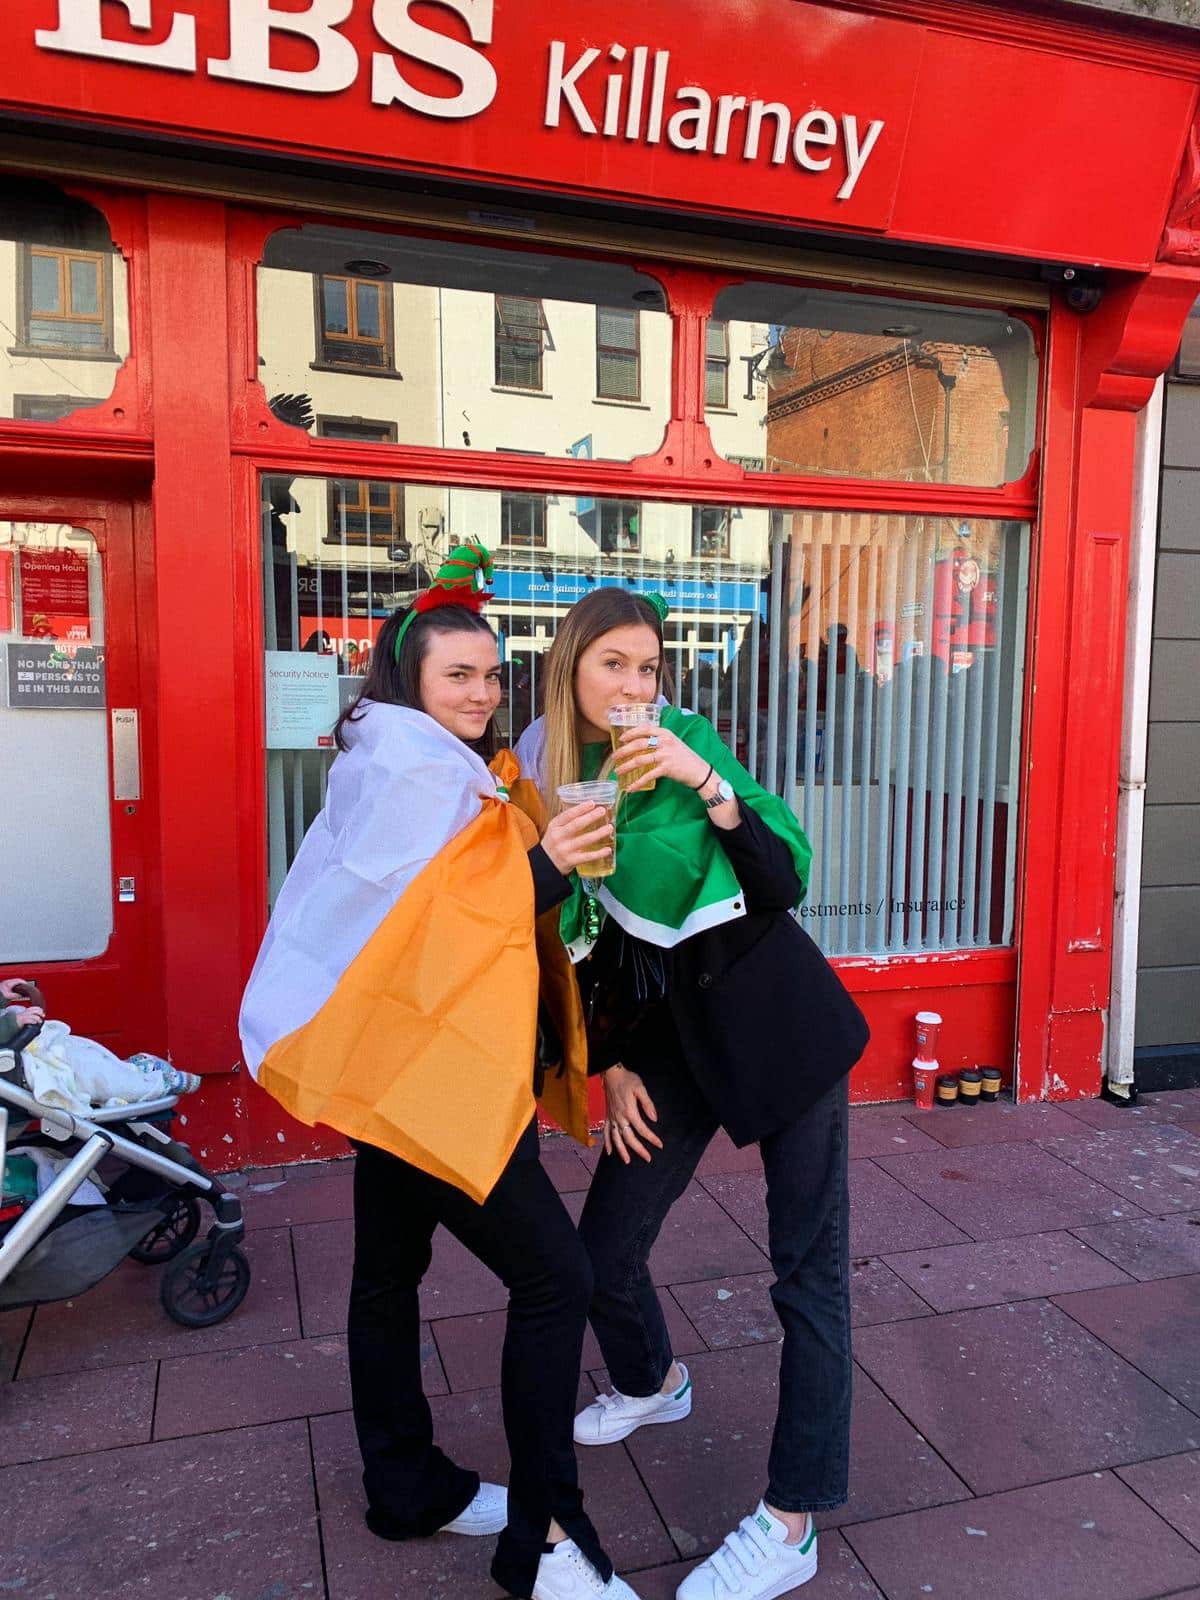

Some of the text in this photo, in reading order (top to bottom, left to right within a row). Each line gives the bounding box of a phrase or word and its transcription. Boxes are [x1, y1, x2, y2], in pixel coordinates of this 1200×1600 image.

[35, 0, 499, 120] EBS
[544, 39, 884, 201] Killarney
[24, 562, 60, 572] Opening
[17, 660, 35, 669] NO
[71, 661, 99, 670] THAN
[85, 673, 101, 682] TO
[269, 669, 330, 680] Security Notice
[18, 684, 100, 694] BE IN THIS AREA
